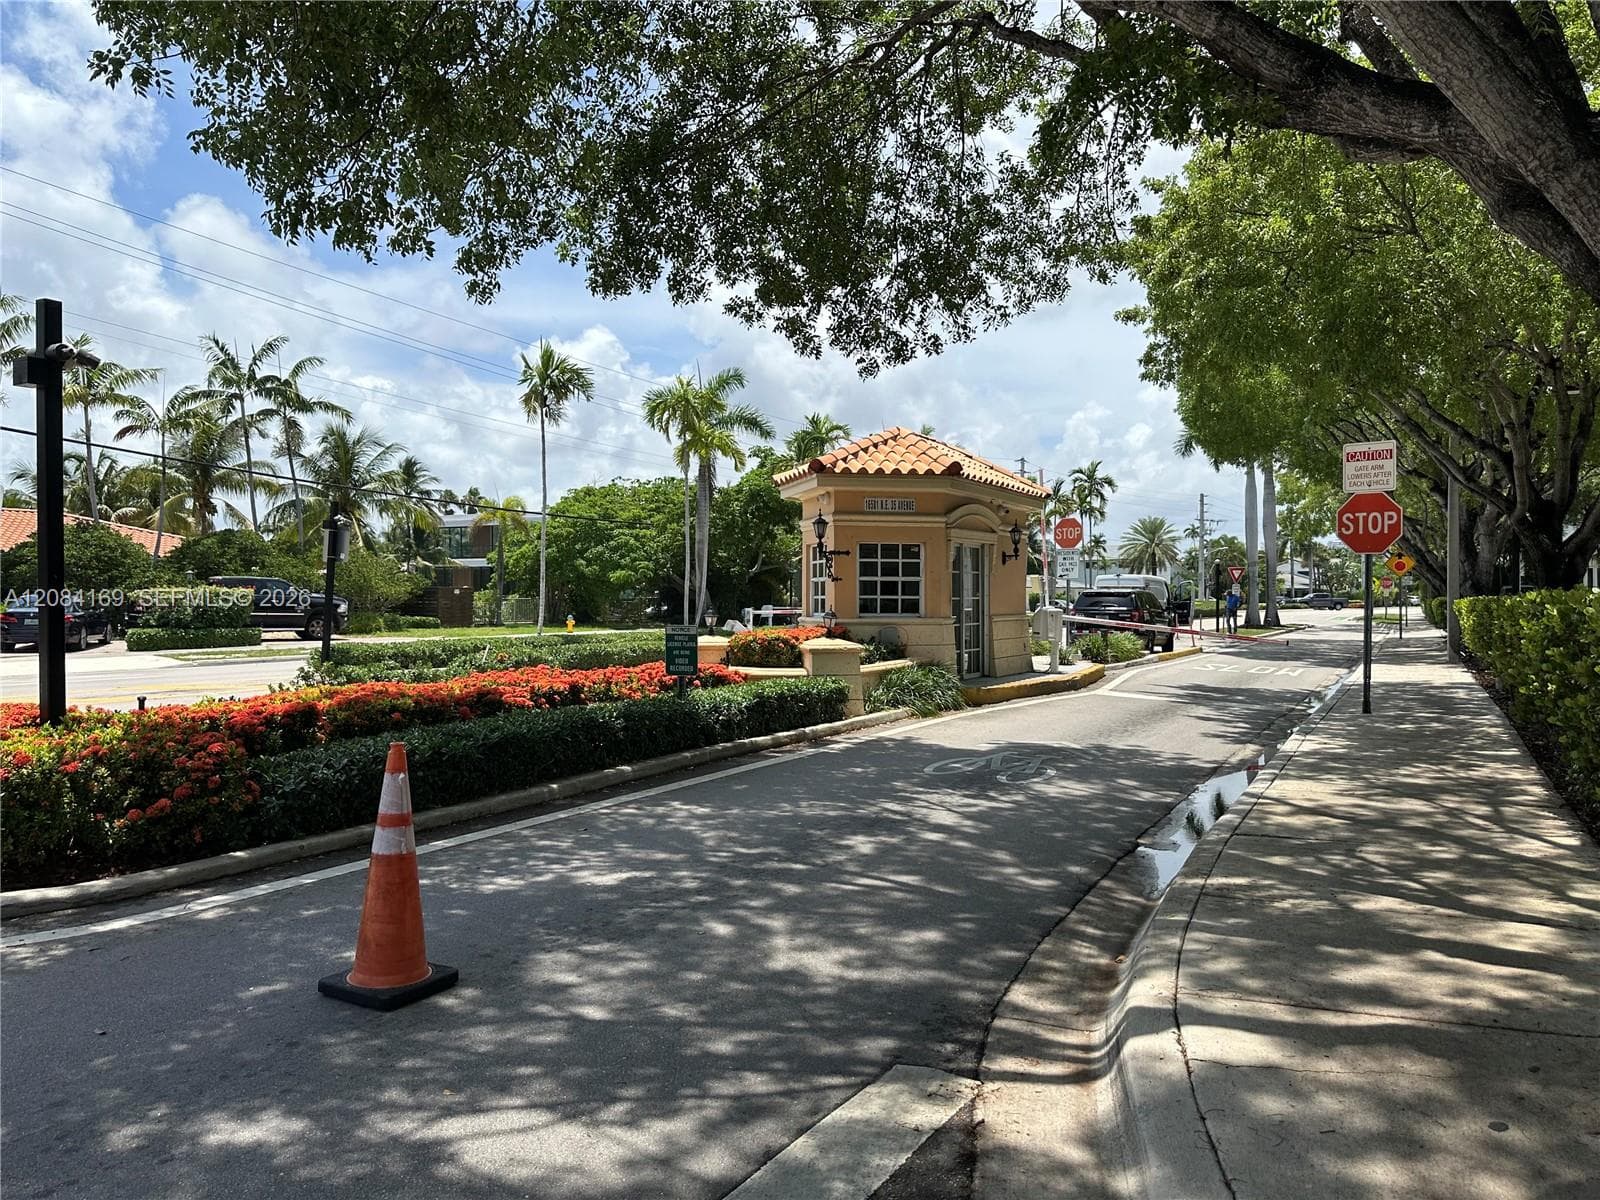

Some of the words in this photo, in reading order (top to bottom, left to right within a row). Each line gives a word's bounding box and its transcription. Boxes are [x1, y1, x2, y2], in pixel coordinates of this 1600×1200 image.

[1348, 450, 1391, 462] CAUTION
[1354, 464, 1370, 473] GATE
[1370, 463, 1385, 471] ARM
[1347, 472, 1372, 480] LOWERS
[1373, 471, 1392, 479] AFTER
[1349, 480, 1365, 488] EACH
[1366, 479, 1390, 487] VEHICLE
[898, 500, 915, 511] AVENUE
[1341, 511, 1398, 535] STOP
[1056, 527, 1081, 540] STOP
[1192, 664, 1304, 677] SLOW
